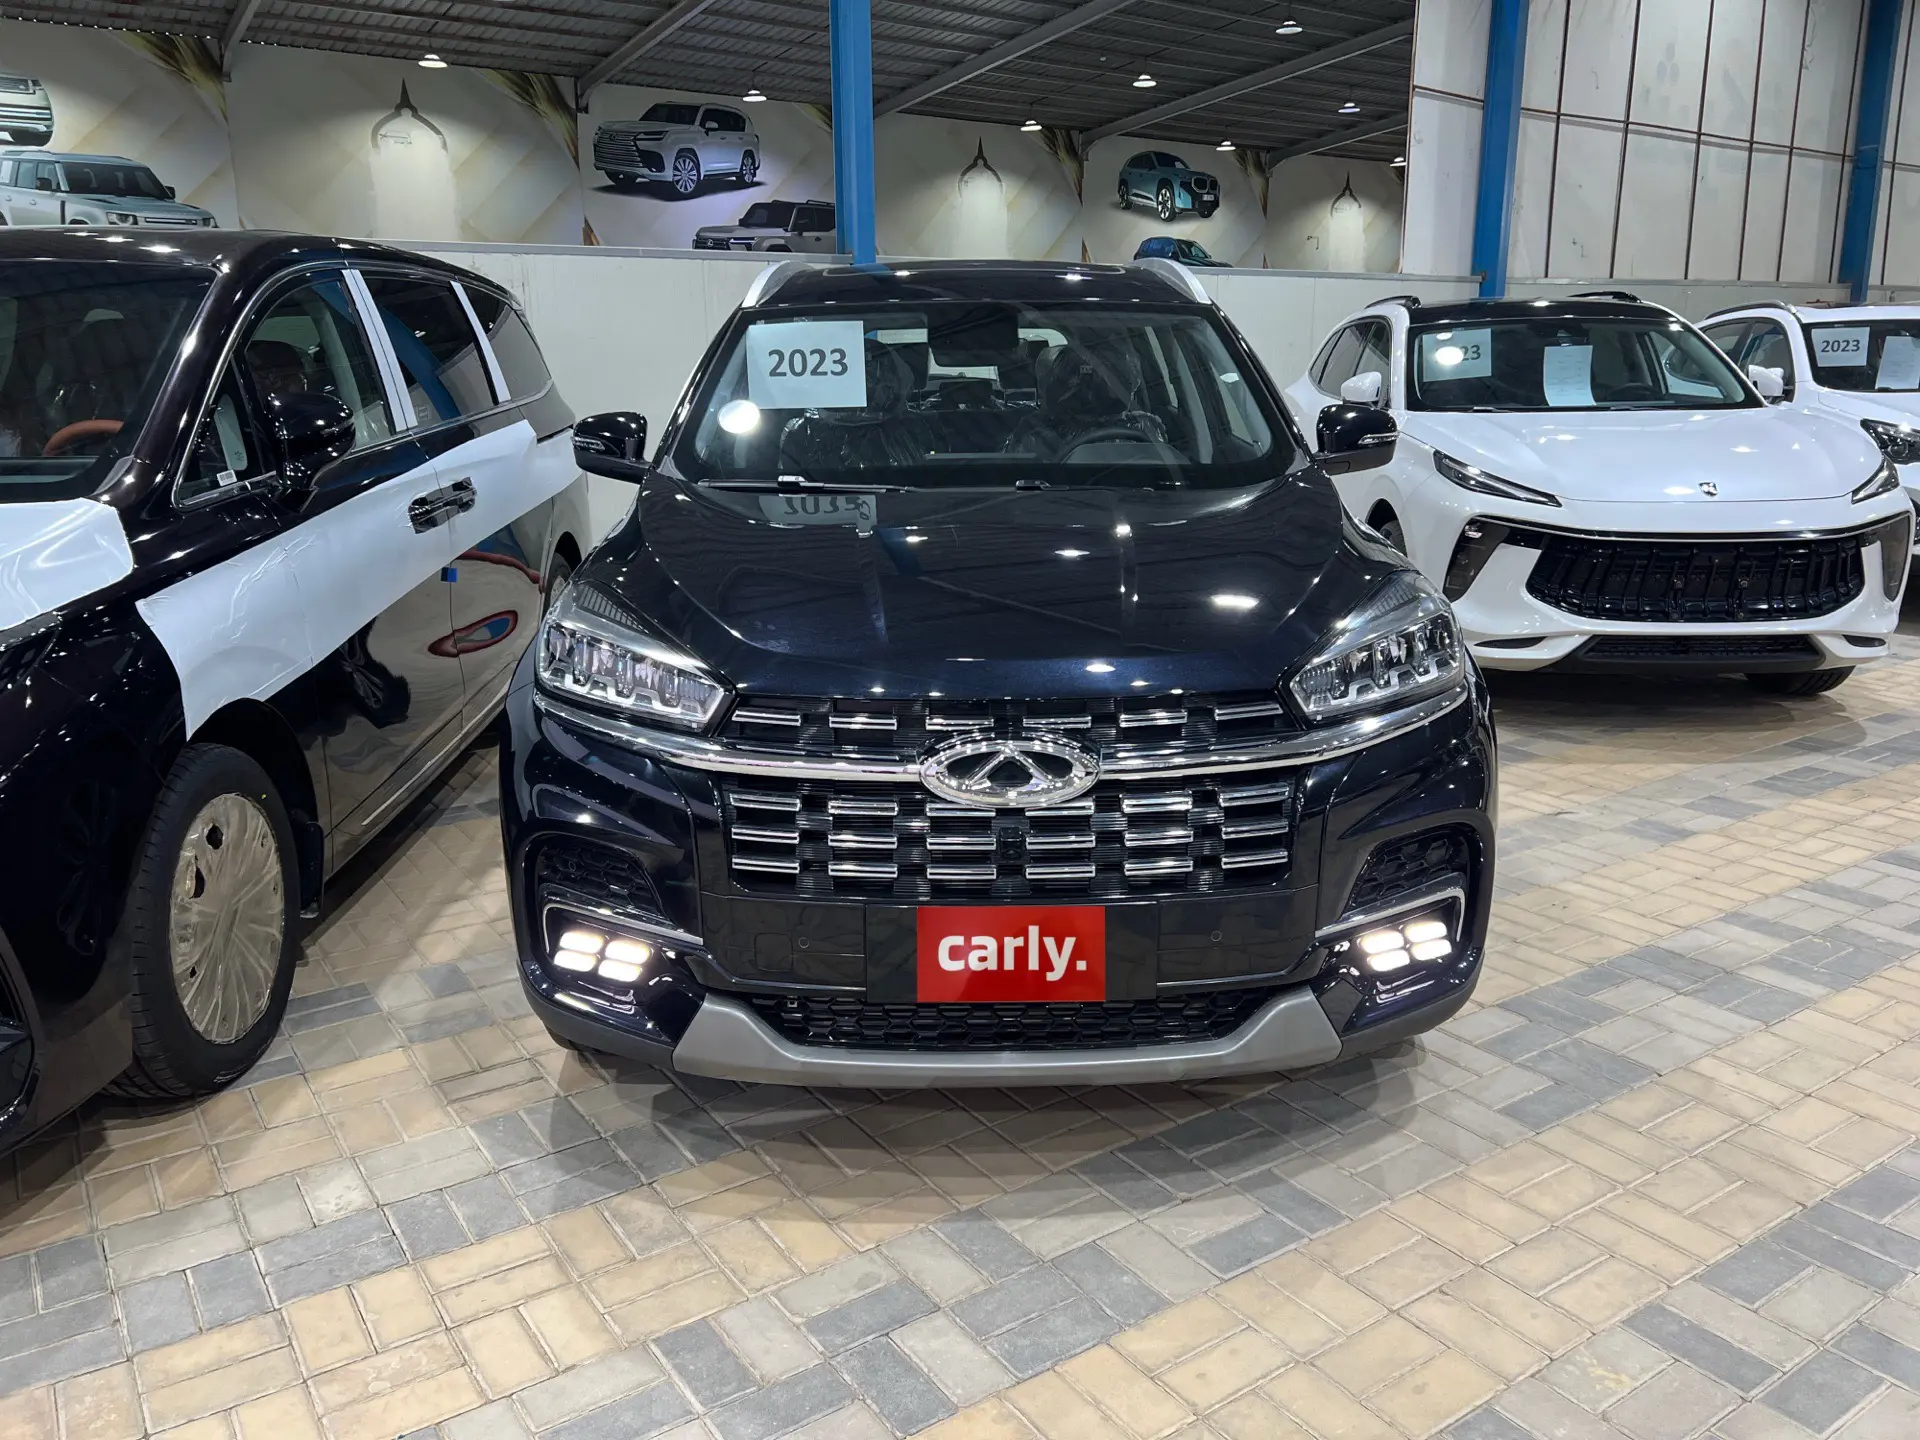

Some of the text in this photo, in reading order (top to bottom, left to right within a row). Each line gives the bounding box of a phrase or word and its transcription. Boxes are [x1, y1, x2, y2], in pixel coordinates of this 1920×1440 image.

[1821, 339, 1860, 352] 2023
[768, 348, 849, 377] 2023
[937, 924, 1087, 982] carly.
